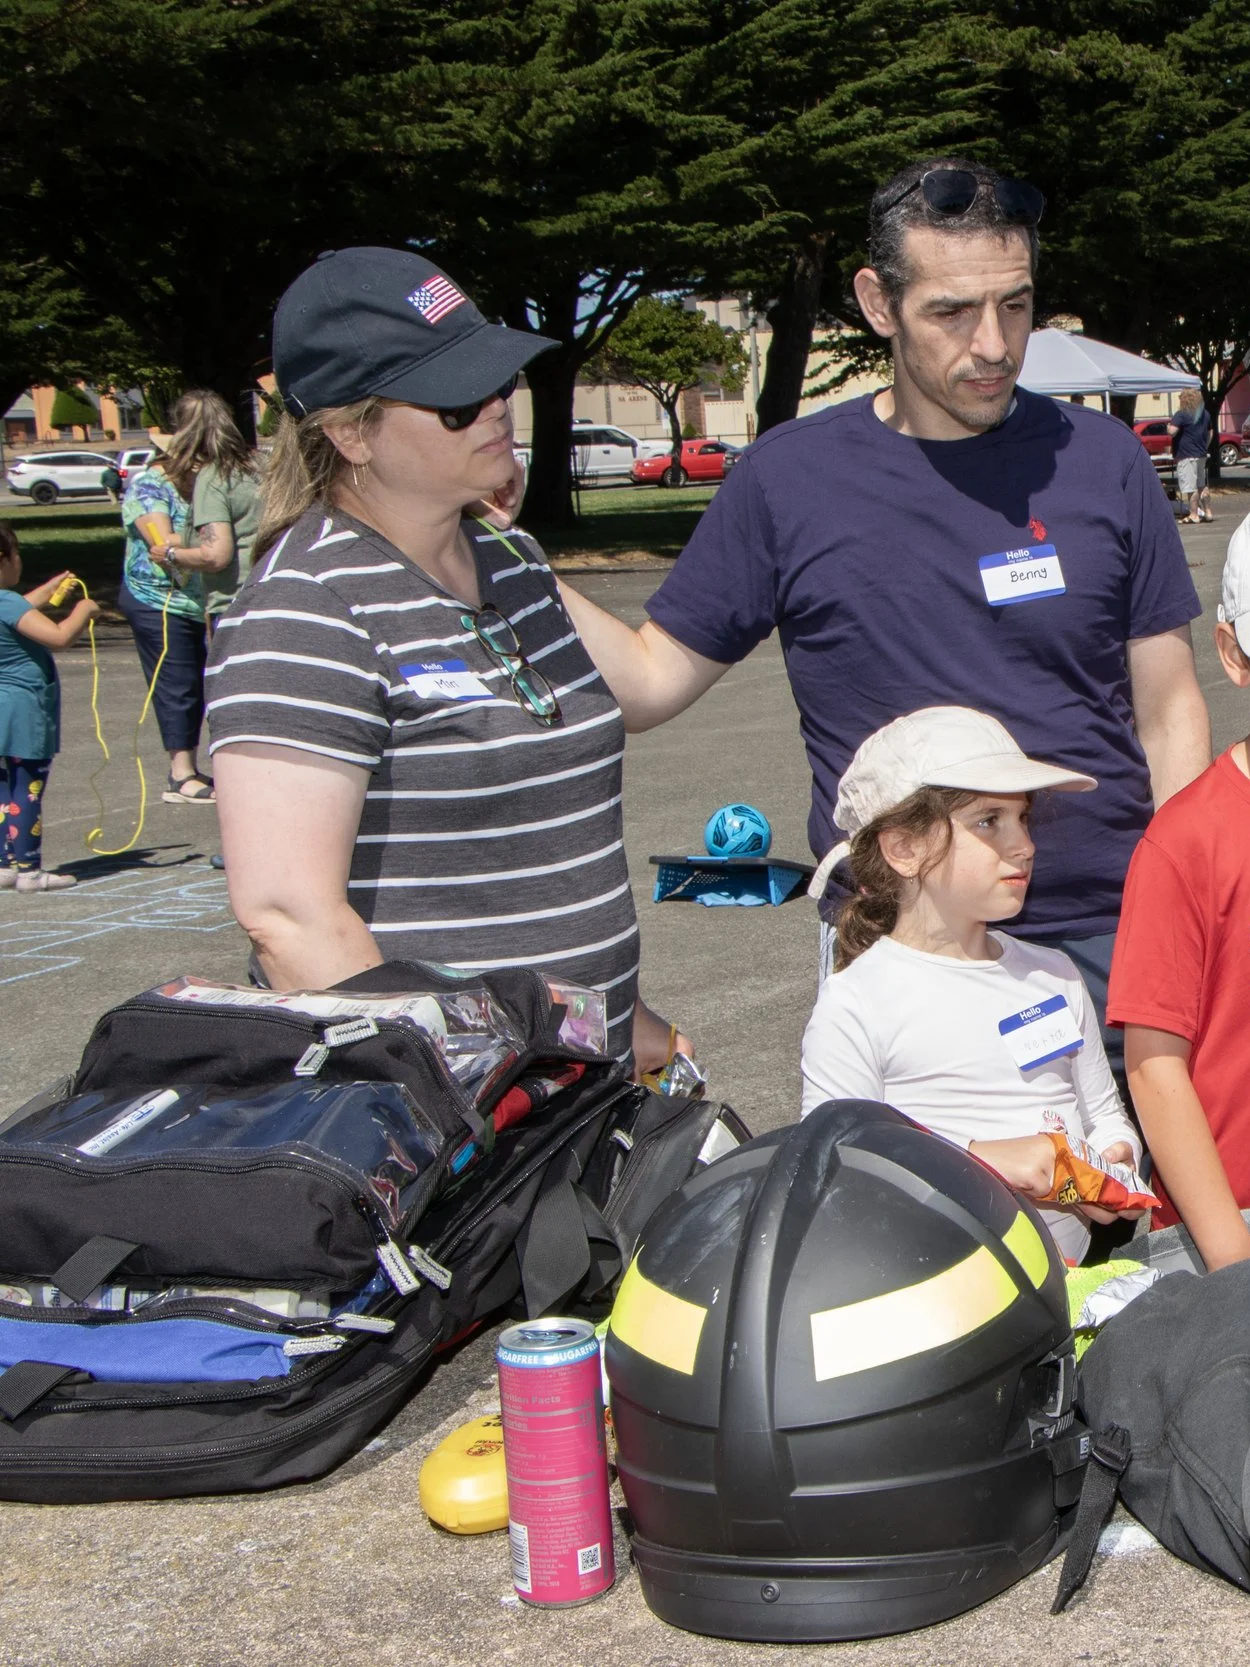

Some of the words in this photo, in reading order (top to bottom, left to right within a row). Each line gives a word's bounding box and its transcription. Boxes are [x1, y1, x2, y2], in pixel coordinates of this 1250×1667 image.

[1006, 549, 1030, 561] Hello
[1010, 567, 1048, 583] Benny
[1020, 1006, 1041, 1021] Hello
